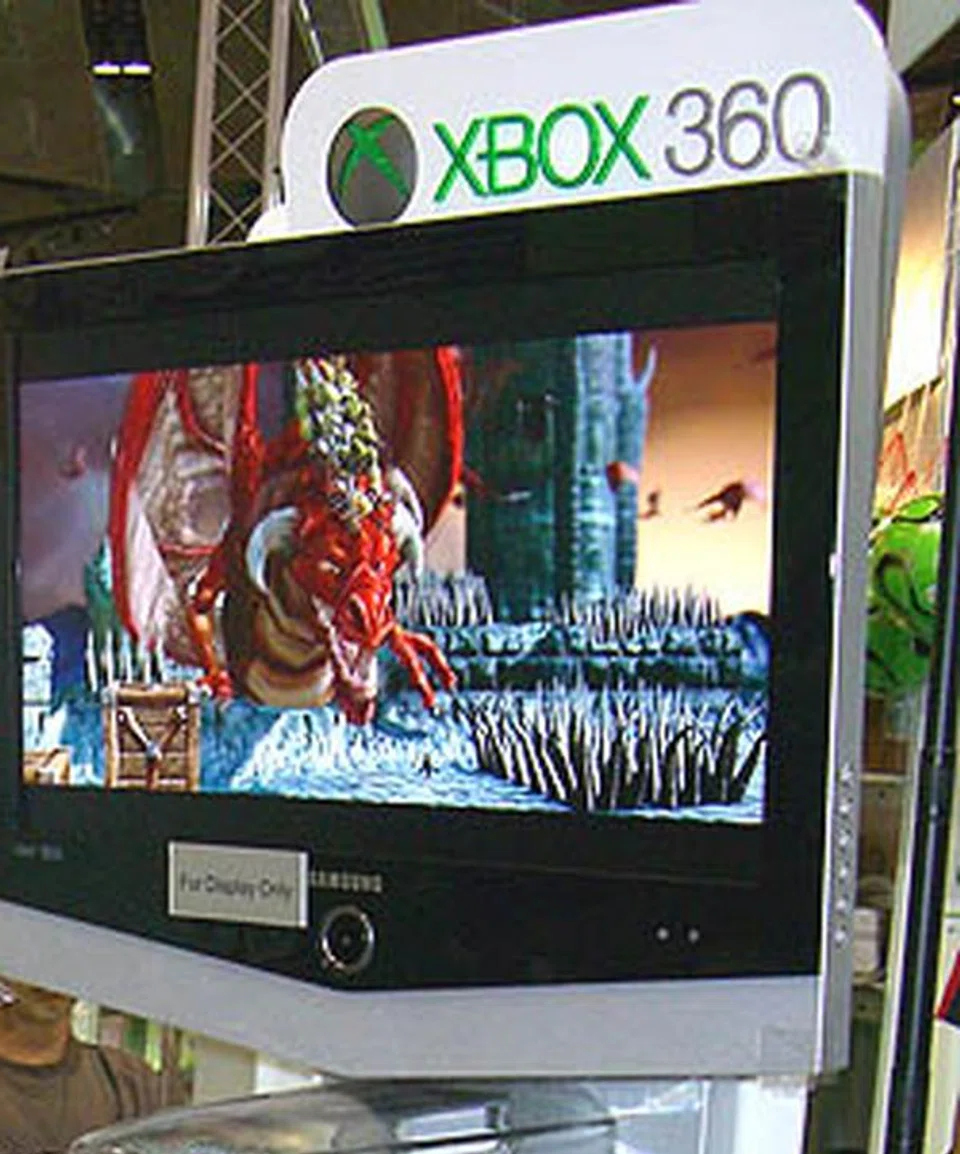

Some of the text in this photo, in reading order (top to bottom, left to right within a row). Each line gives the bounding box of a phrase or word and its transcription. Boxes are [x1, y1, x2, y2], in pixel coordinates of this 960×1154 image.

[432, 72, 831, 203] XBOX 360
[205, 873, 256, 902] Display
